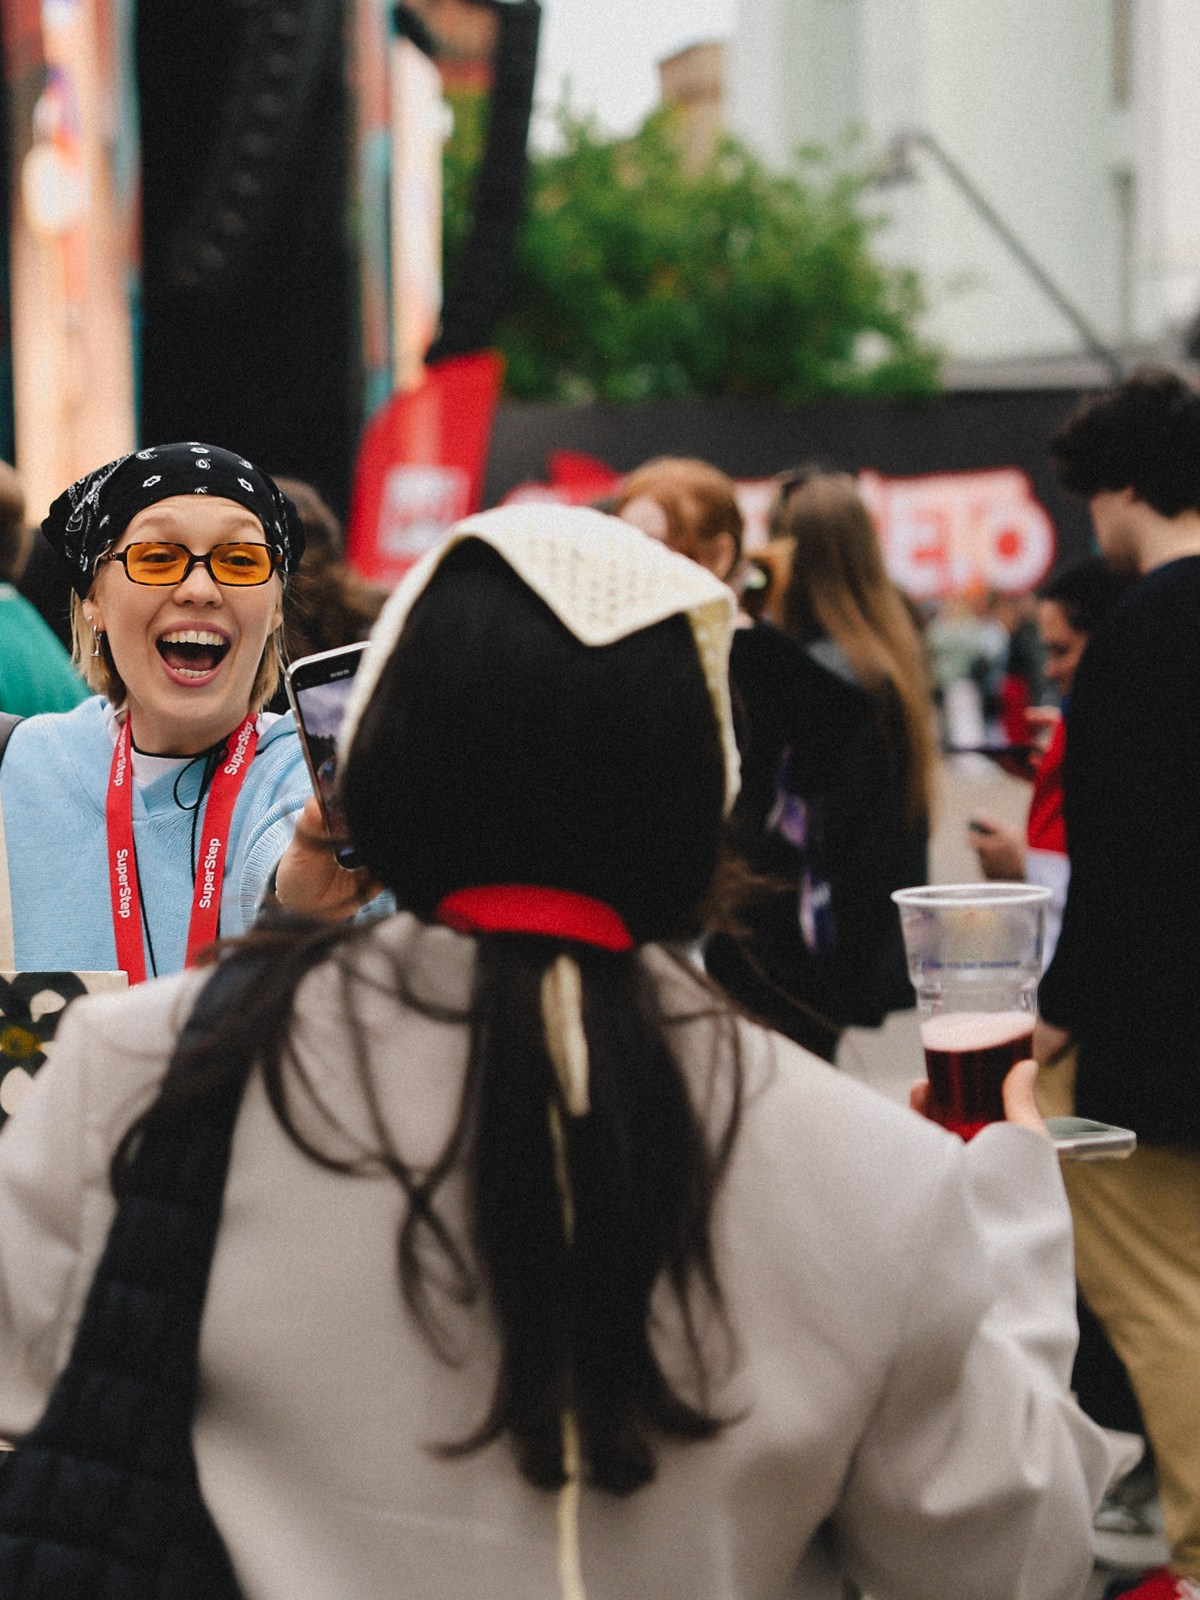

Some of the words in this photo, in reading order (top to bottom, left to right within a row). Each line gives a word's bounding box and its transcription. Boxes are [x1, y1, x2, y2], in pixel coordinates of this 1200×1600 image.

[224, 721, 254, 776] SuperStep
[116, 848, 131, 919] SuperStep
[199, 837, 221, 909] SuperStep
